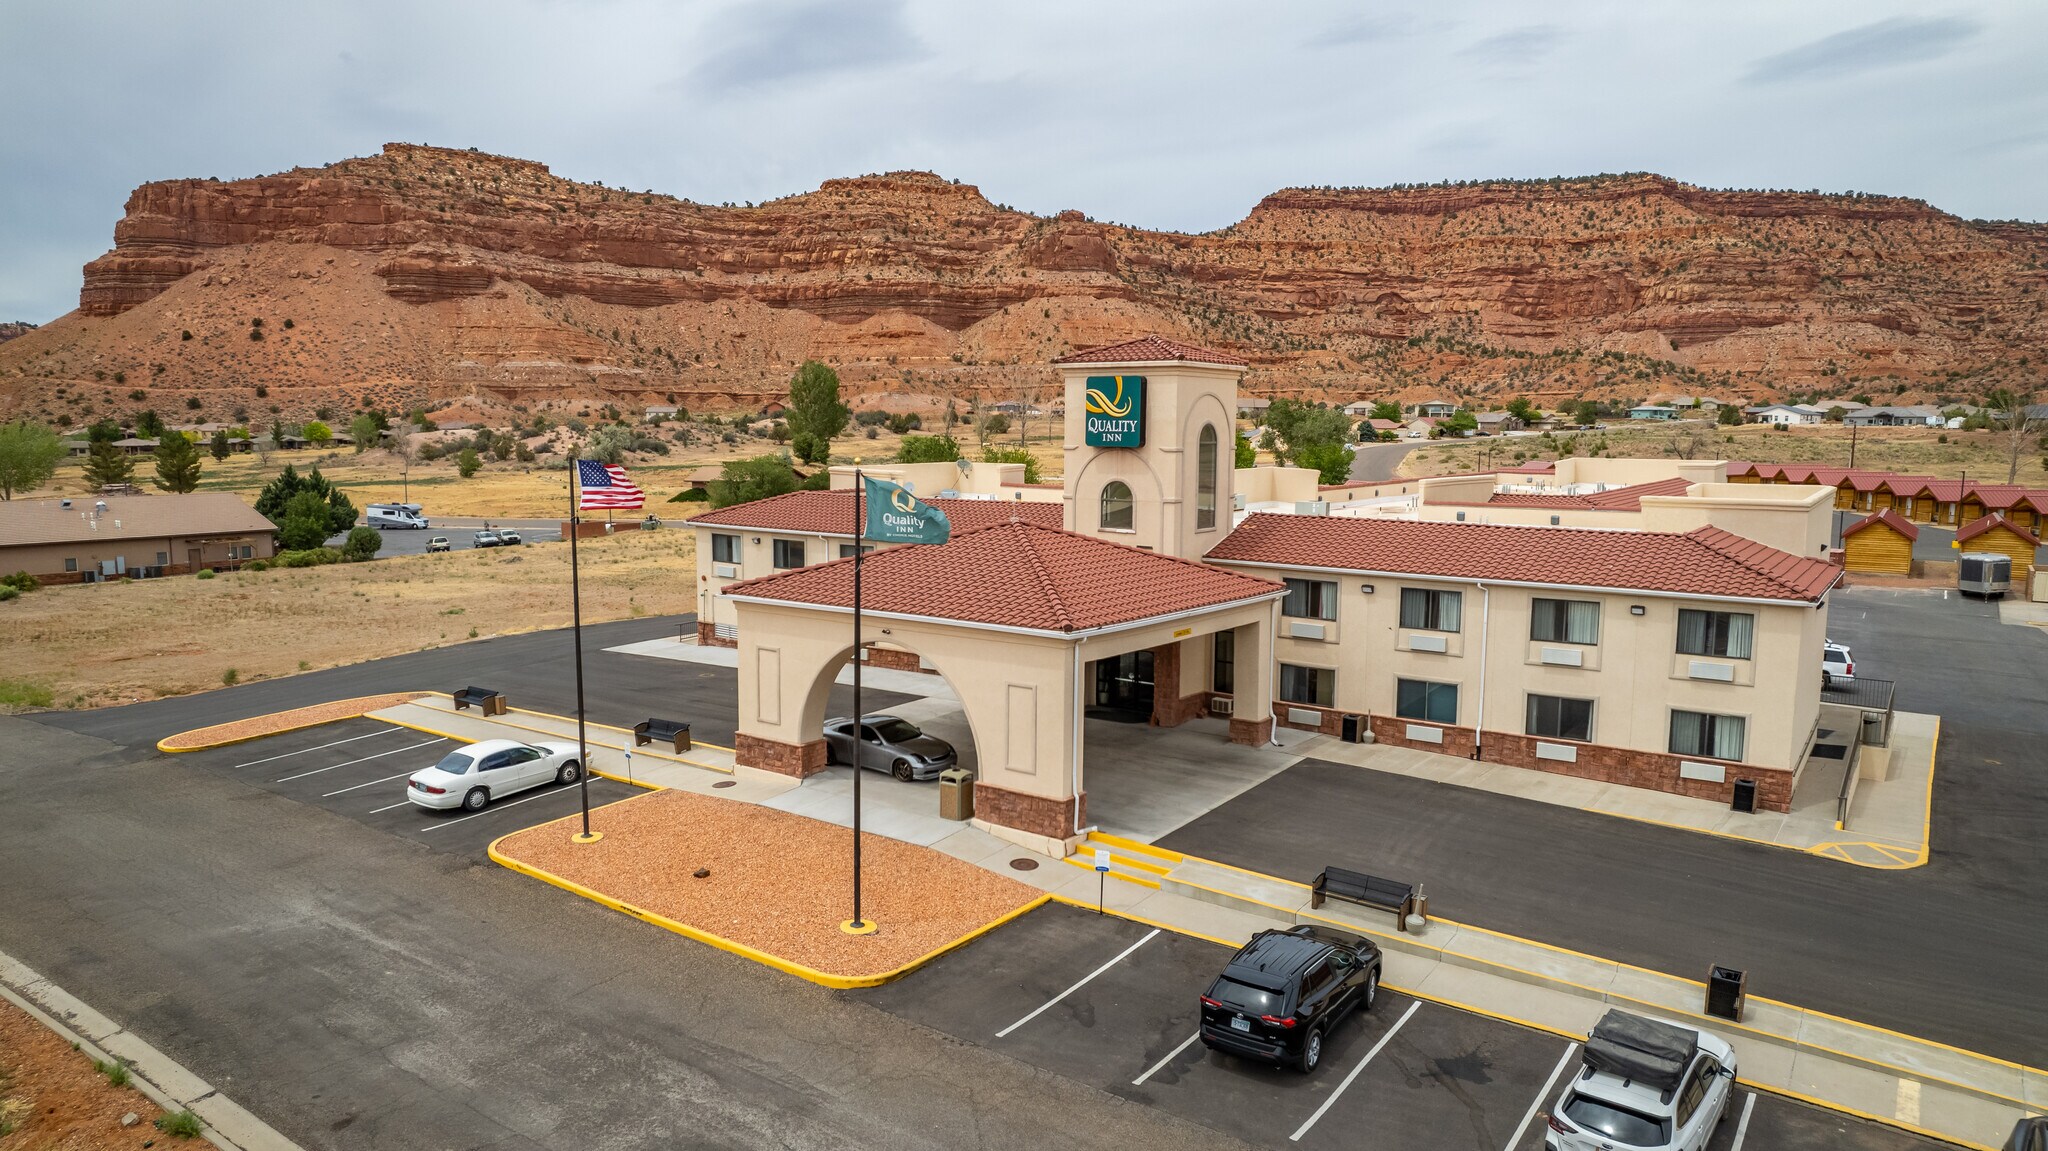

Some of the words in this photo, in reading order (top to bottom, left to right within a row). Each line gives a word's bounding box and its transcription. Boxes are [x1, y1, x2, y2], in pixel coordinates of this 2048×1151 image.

[1088, 417, 1137, 433] QUALITY
[1102, 433, 1122, 442] INN
[883, 512, 925, 529] Quality
